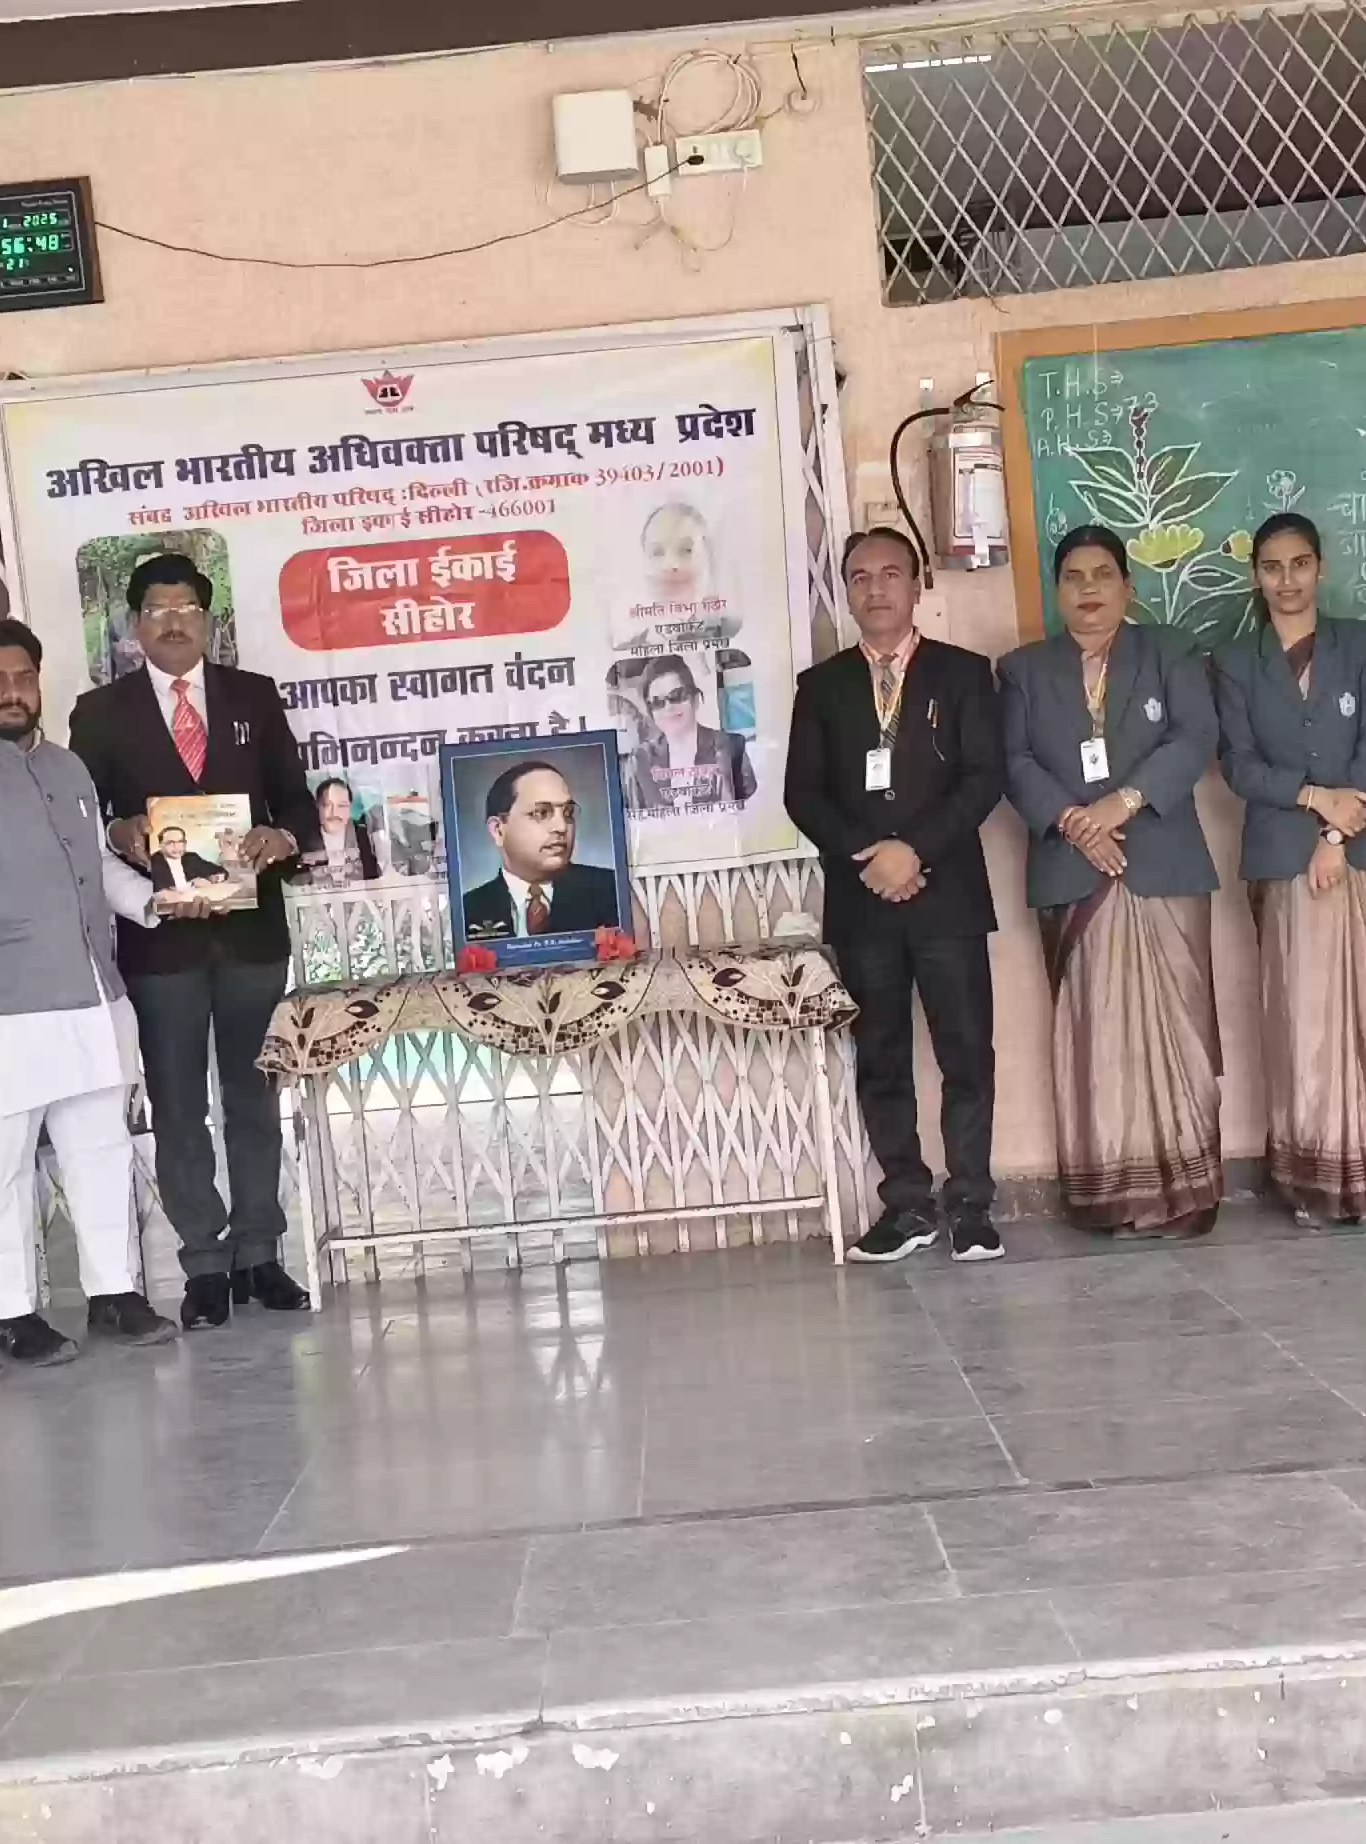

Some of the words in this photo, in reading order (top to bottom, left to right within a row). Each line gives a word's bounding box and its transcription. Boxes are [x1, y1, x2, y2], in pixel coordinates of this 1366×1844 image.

[46, 457, 165, 499] अखिल
[176, 443, 297, 485] भारतीय
[308, 434, 466, 474] अधिवक्ता
[473, 420, 583, 459] परिषद्
[587, 416, 657, 448] मध्य
[675, 403, 757, 443] प्रदेश
[183, 500, 251, 521] अखिल
[257, 491, 329, 514] भारतीय
[301, 515, 356, 536] जिला
[326, 556, 420, 593] जिला
[427, 540, 518, 588] ईकाई
[379, 595, 477, 636] सीहोर
[279, 673, 379, 710] आपका
[388, 662, 494, 702] स्वागत
[295, 730, 448, 770] भिनन्दन
